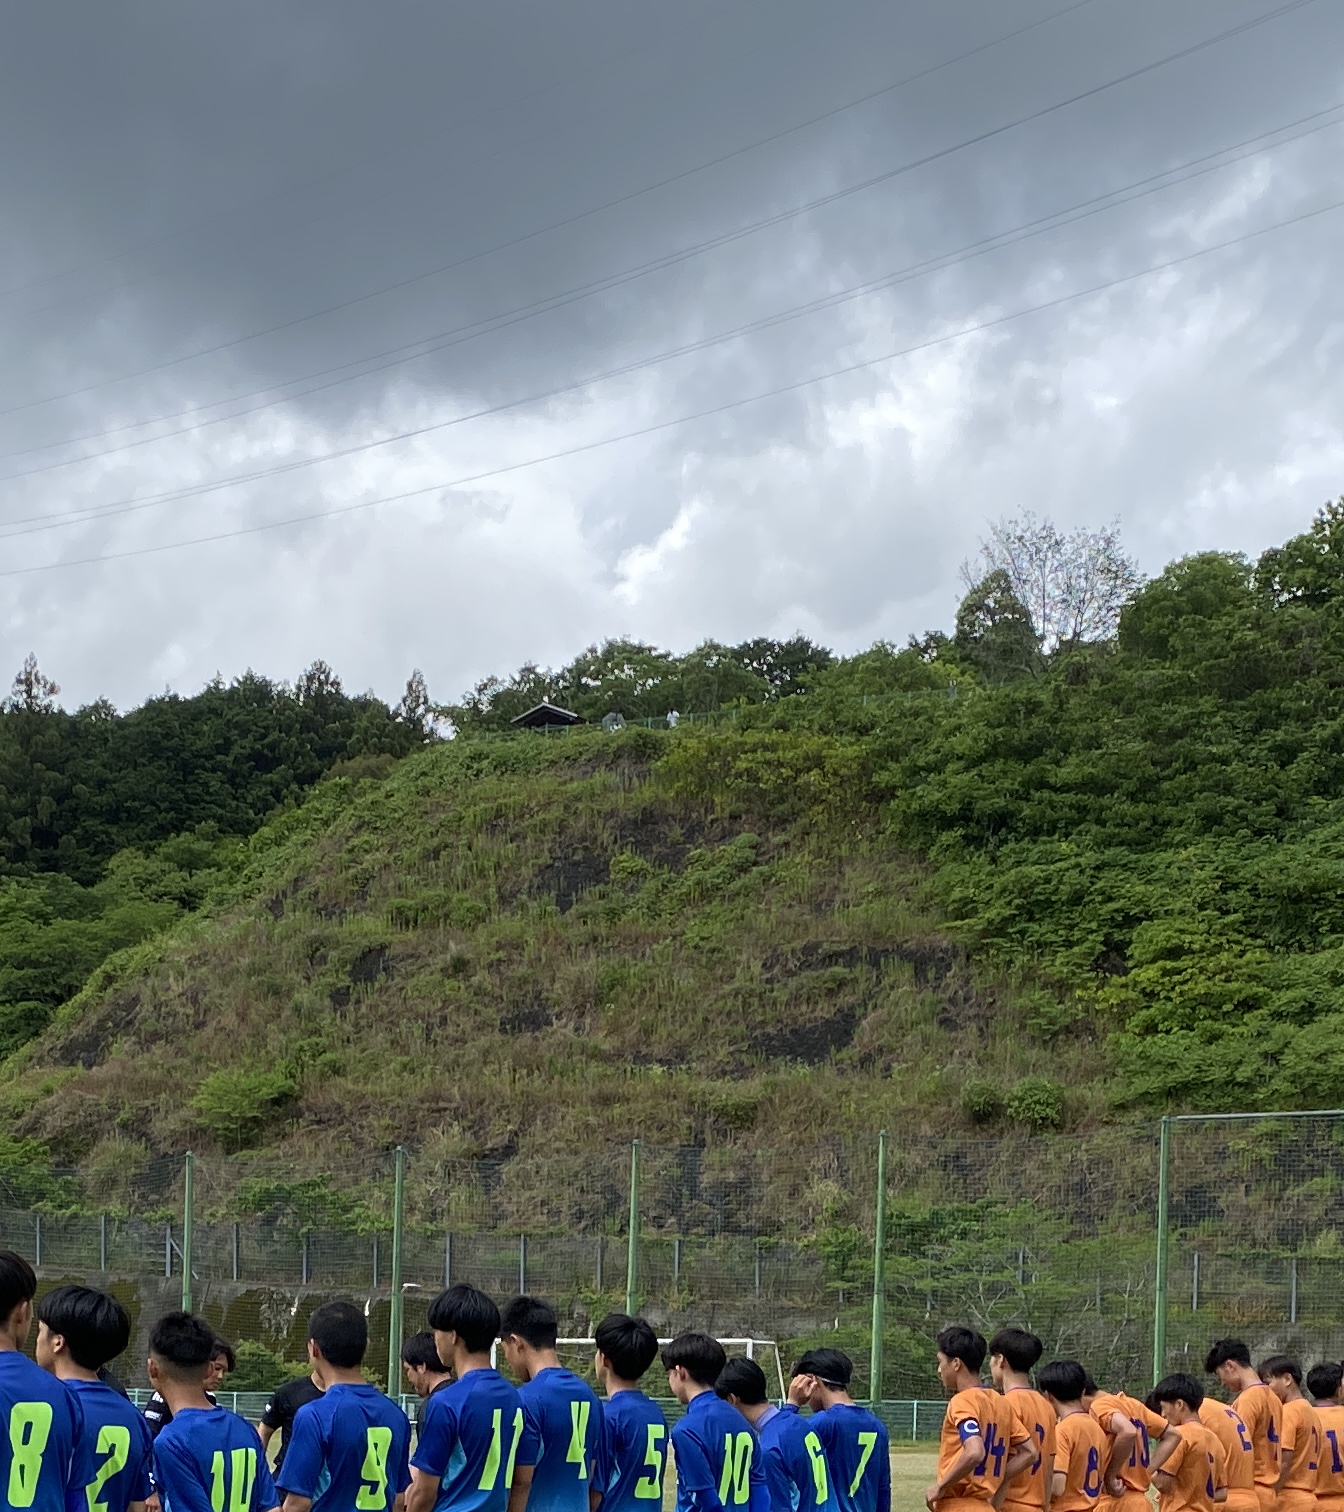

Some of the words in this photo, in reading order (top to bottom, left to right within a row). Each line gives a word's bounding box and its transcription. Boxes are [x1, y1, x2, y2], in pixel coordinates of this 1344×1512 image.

[8, 1402, 53, 1507] 8
[478, 1407, 524, 1491] 11
[566, 1401, 591, 1479] 4
[634, 1424, 665, 1499] 5
[963, 1419, 980, 1433] C
[973, 1422, 1006, 1477] 14
[1223, 1408, 1253, 1452] 2
[355, 1427, 393, 1510] 9
[718, 1431, 754, 1506] 10
[804, 1431, 829, 1505] 6
[847, 1432, 878, 1498] 7
[1083, 1445, 1102, 1498] 8
